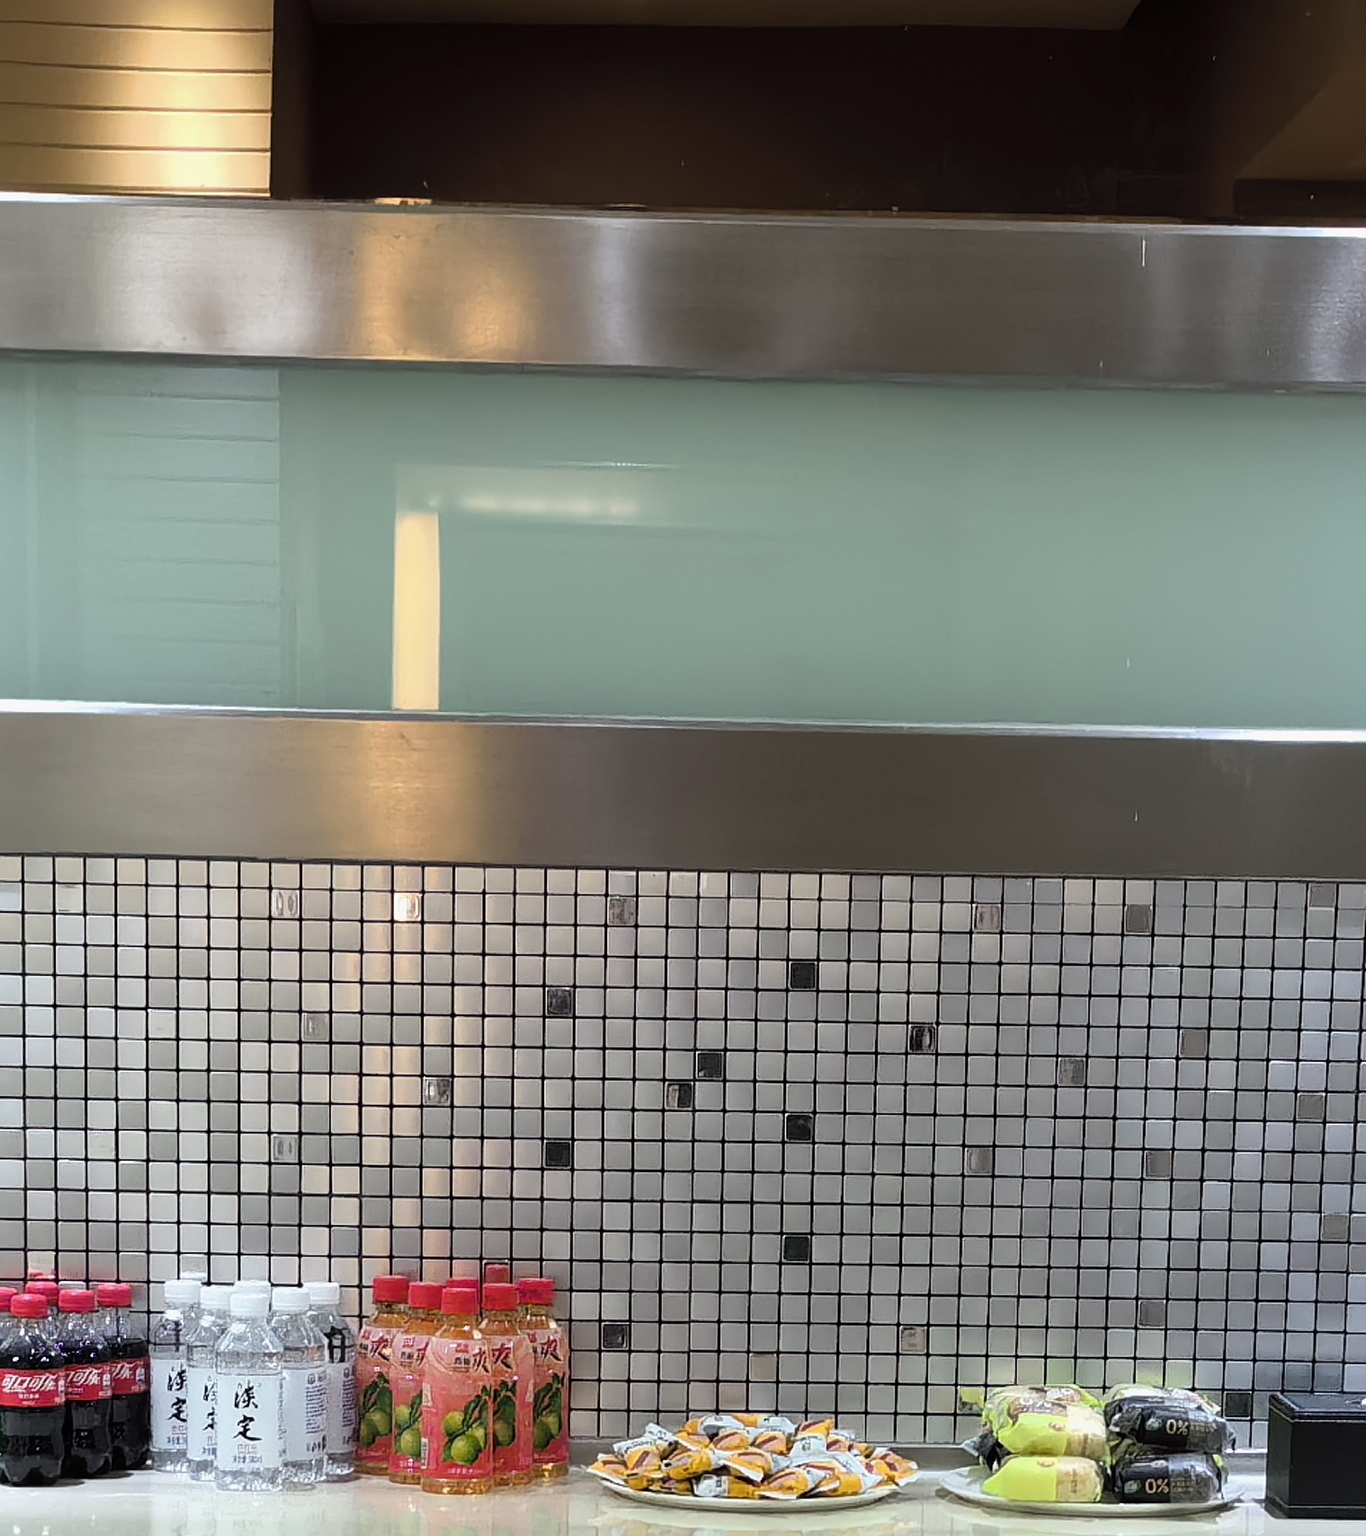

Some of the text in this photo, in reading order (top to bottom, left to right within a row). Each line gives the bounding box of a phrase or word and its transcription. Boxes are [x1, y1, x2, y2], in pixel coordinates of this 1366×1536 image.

[1, 1373, 57, 1393] 可口可乐
[233, 1380, 263, 1442] 淡定
[1145, 1478, 1170, 1494] 0%
